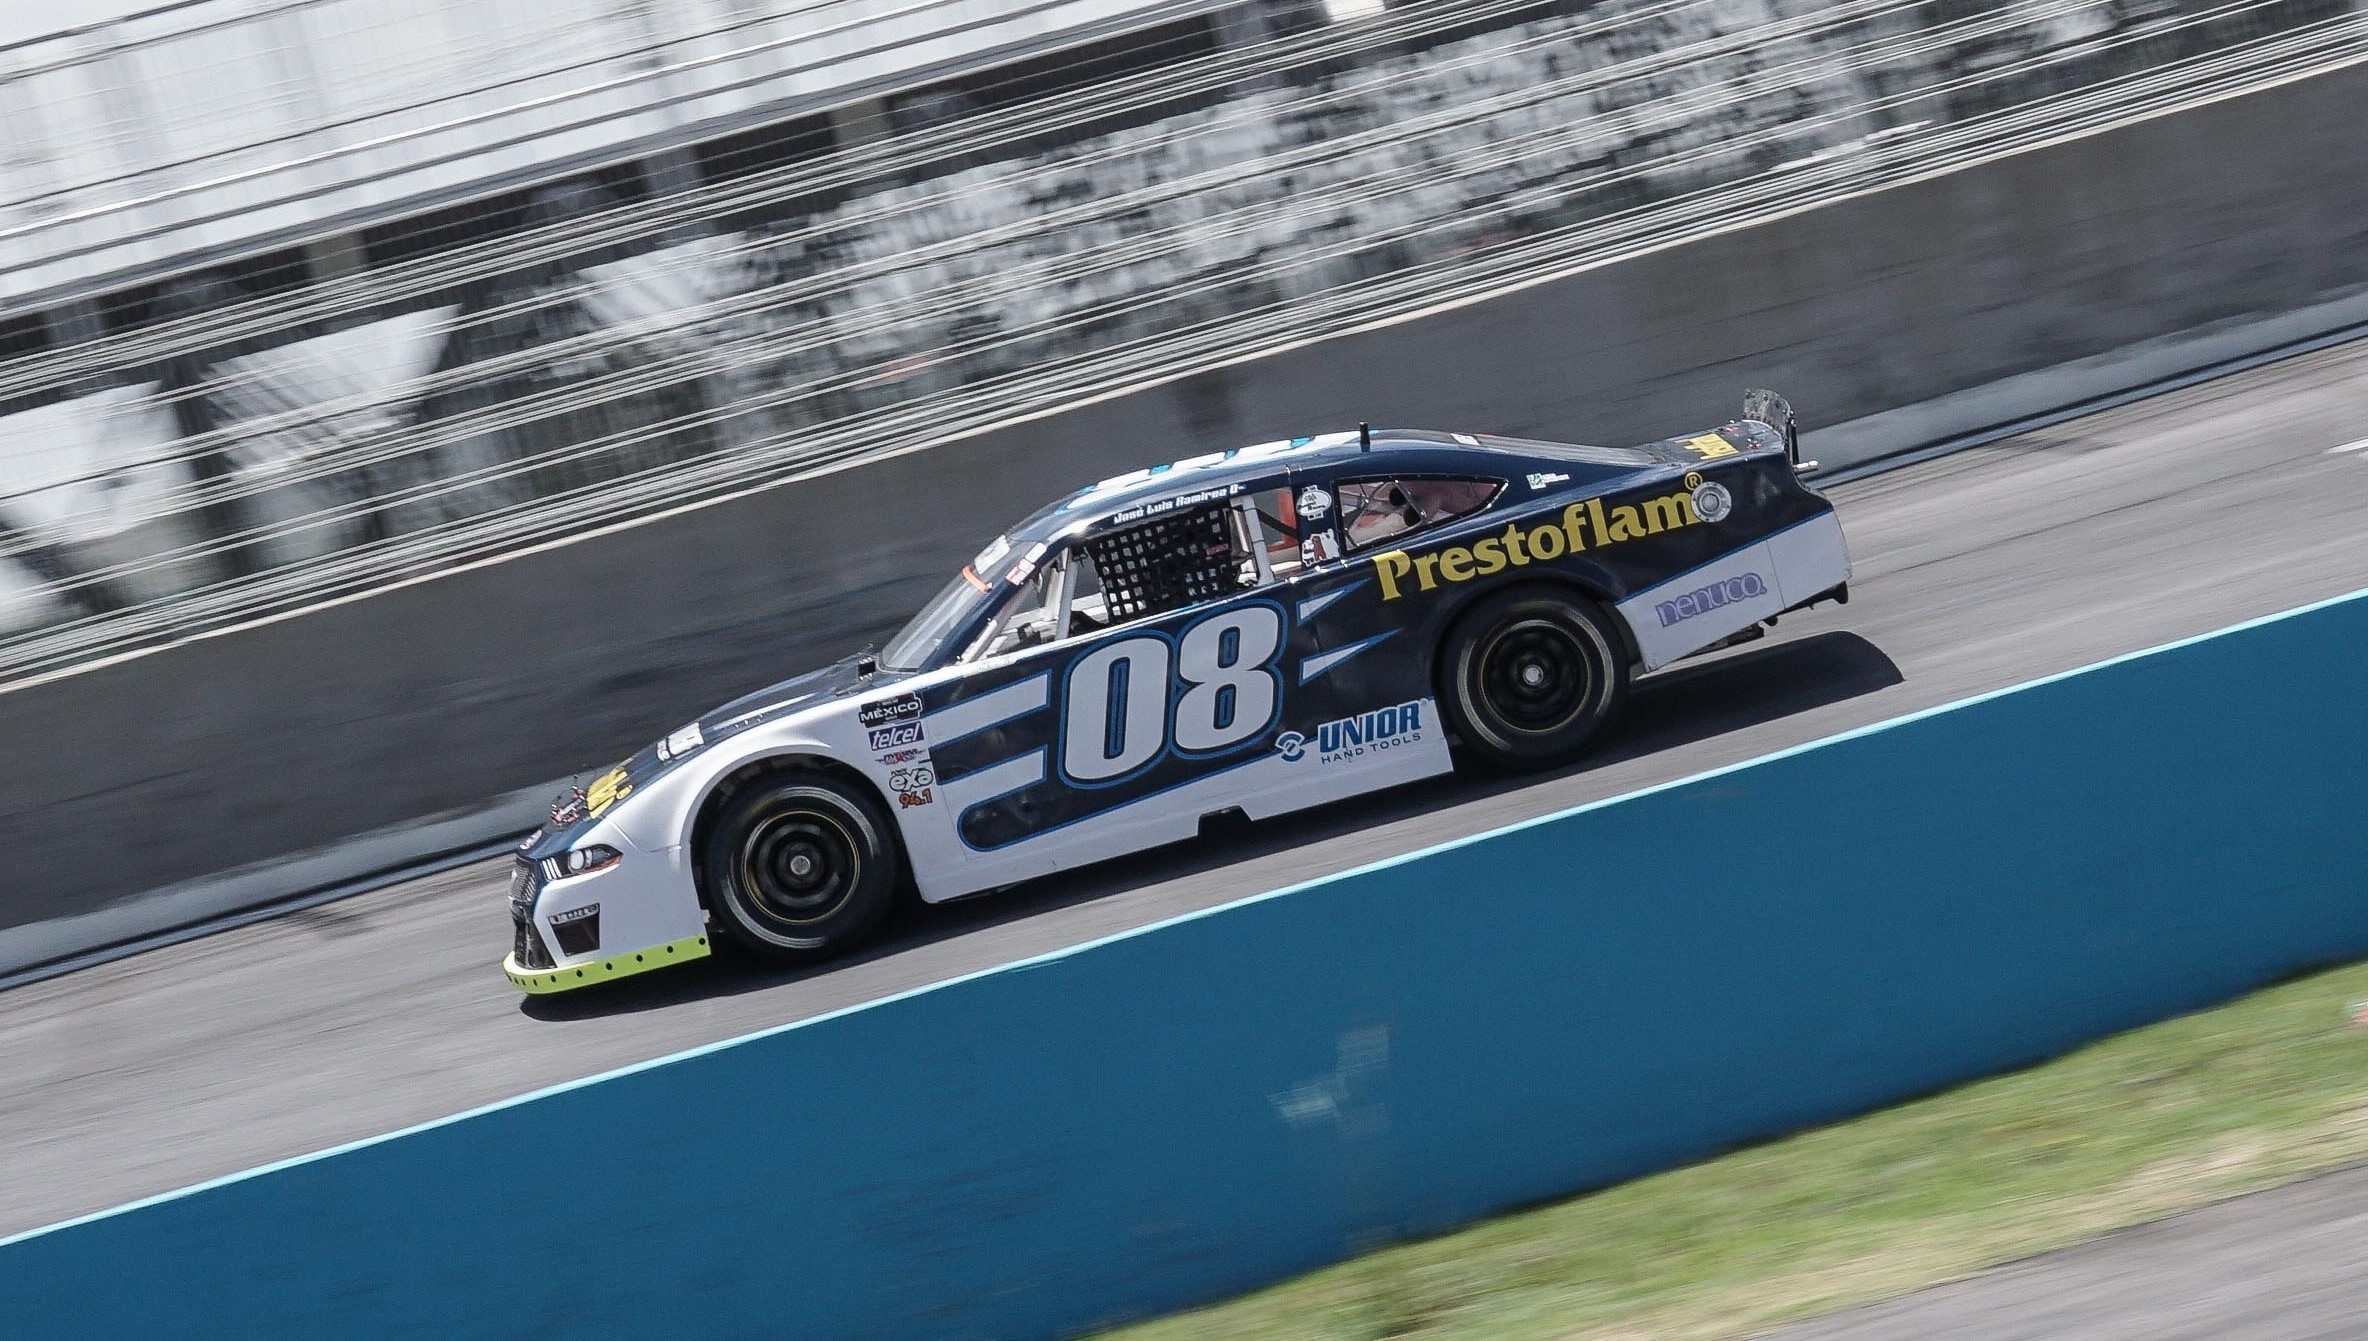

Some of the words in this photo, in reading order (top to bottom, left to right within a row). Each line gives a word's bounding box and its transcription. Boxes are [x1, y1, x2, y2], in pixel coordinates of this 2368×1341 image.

[1147, 500, 1174, 515] Luis
[1064, 606, 1279, 780] 08
[860, 701, 919, 722] MÉXICO
[872, 722, 921, 750] telcel
[1319, 701, 1422, 753] UNIOR
[1321, 747, 1364, 765] HAND
[1370, 732, 1422, 752] TOOLS
[889, 768, 933, 792] exa
